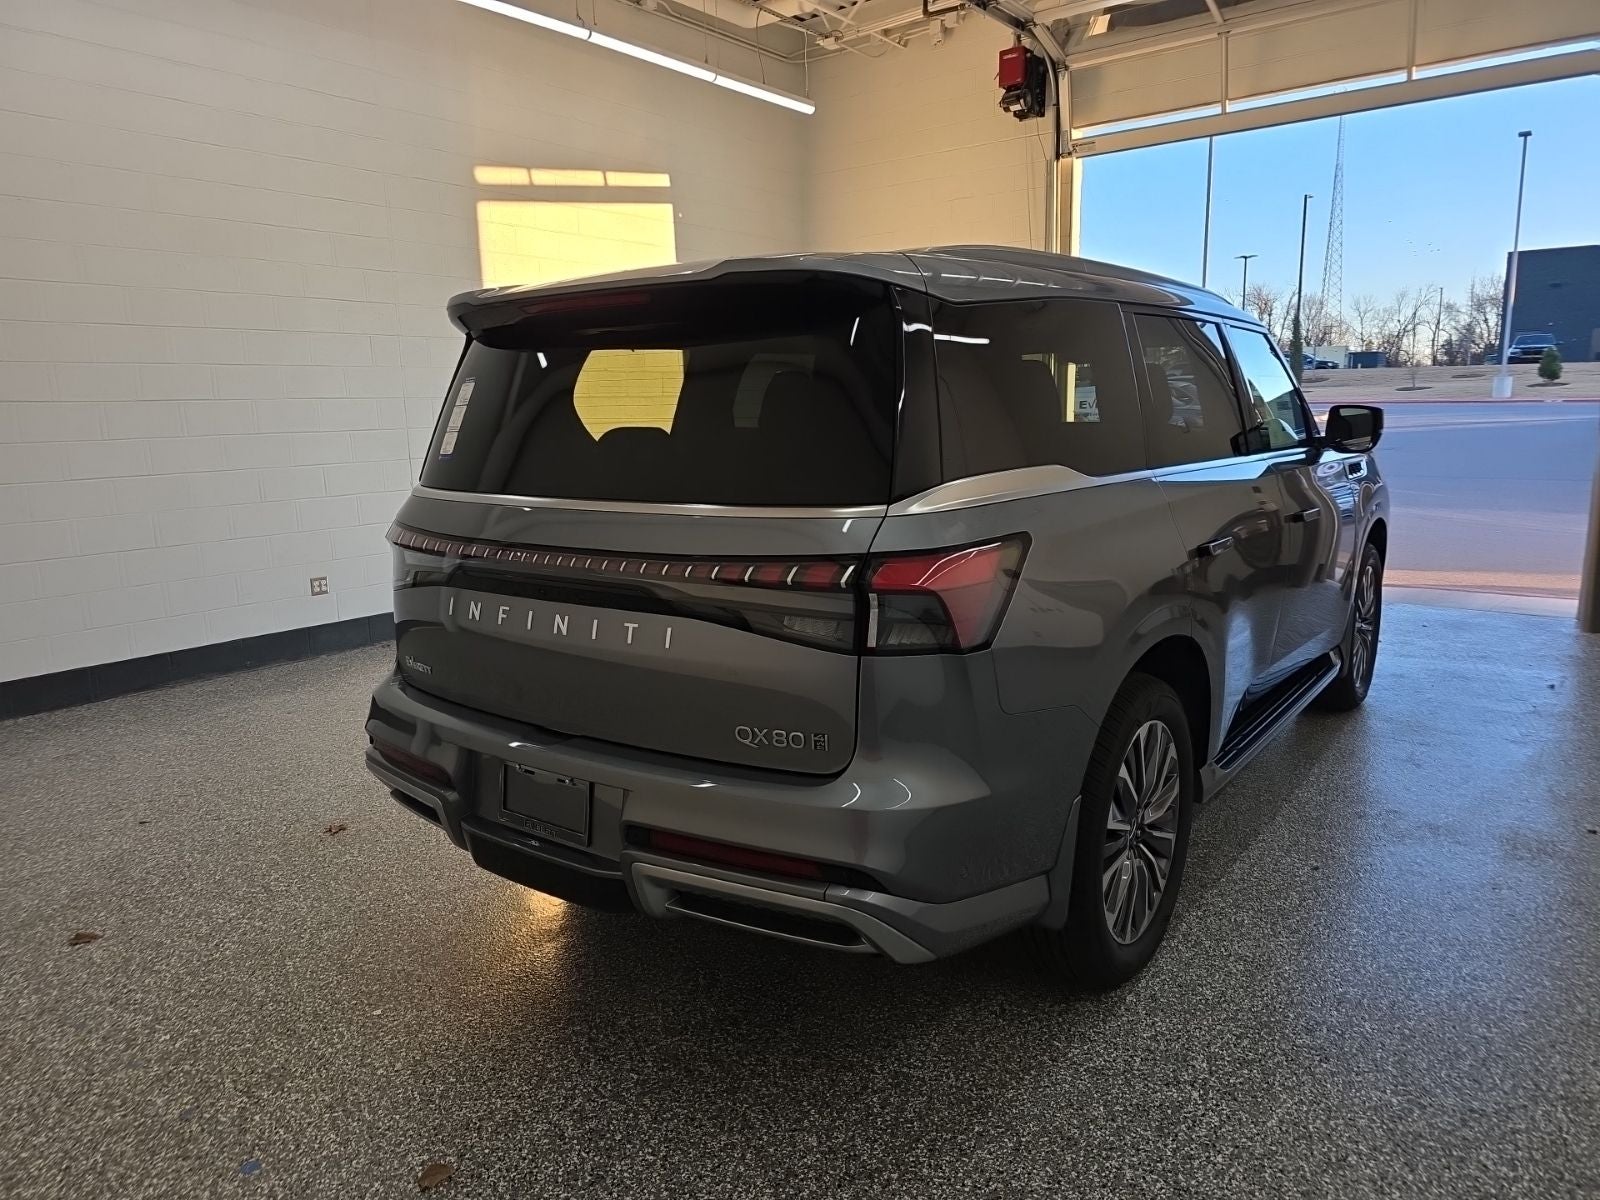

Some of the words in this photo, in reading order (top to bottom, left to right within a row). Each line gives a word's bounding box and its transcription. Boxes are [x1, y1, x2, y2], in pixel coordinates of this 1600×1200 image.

[1079, 399, 1097, 409] EV
[448, 596, 672, 649] INFINITI
[734, 725, 805, 749] QX80
